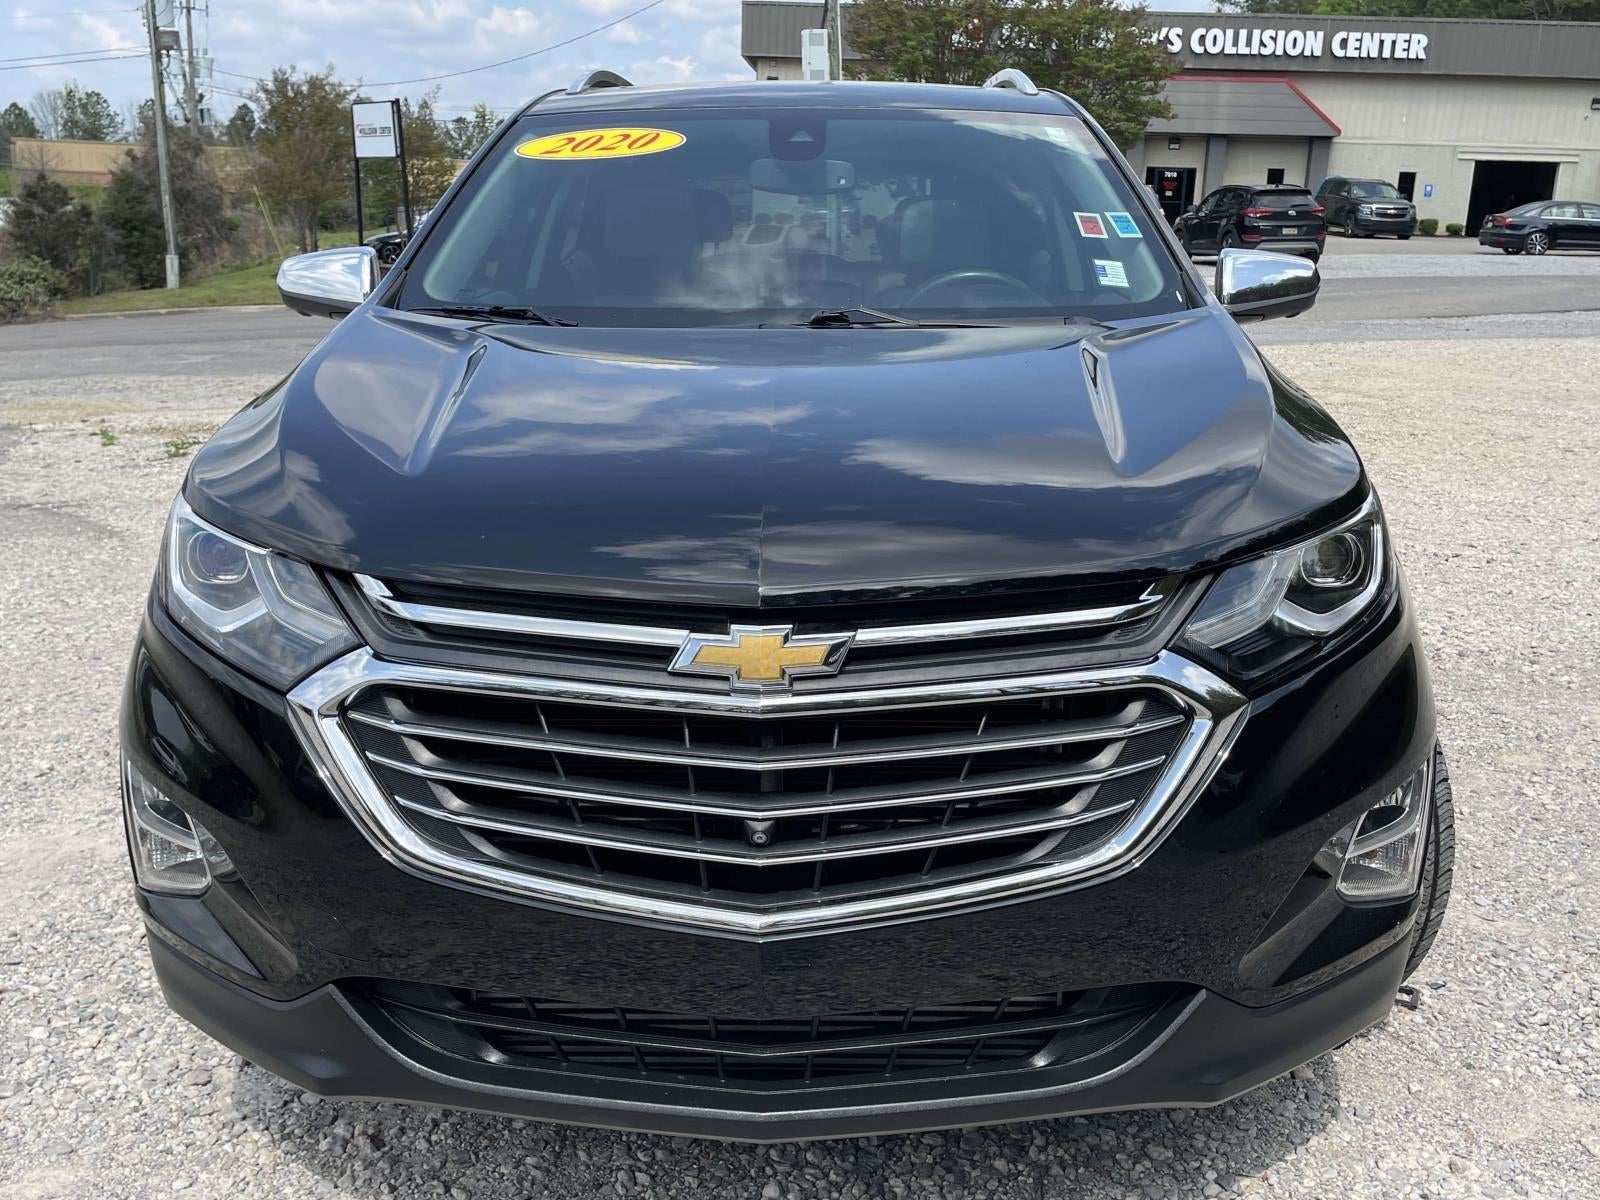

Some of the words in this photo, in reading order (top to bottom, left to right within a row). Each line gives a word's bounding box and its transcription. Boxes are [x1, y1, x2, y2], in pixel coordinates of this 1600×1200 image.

[1190, 27, 1325, 56] COLLISION
[1331, 31, 1428, 59] CENTER
[539, 132, 661, 155] 2020
